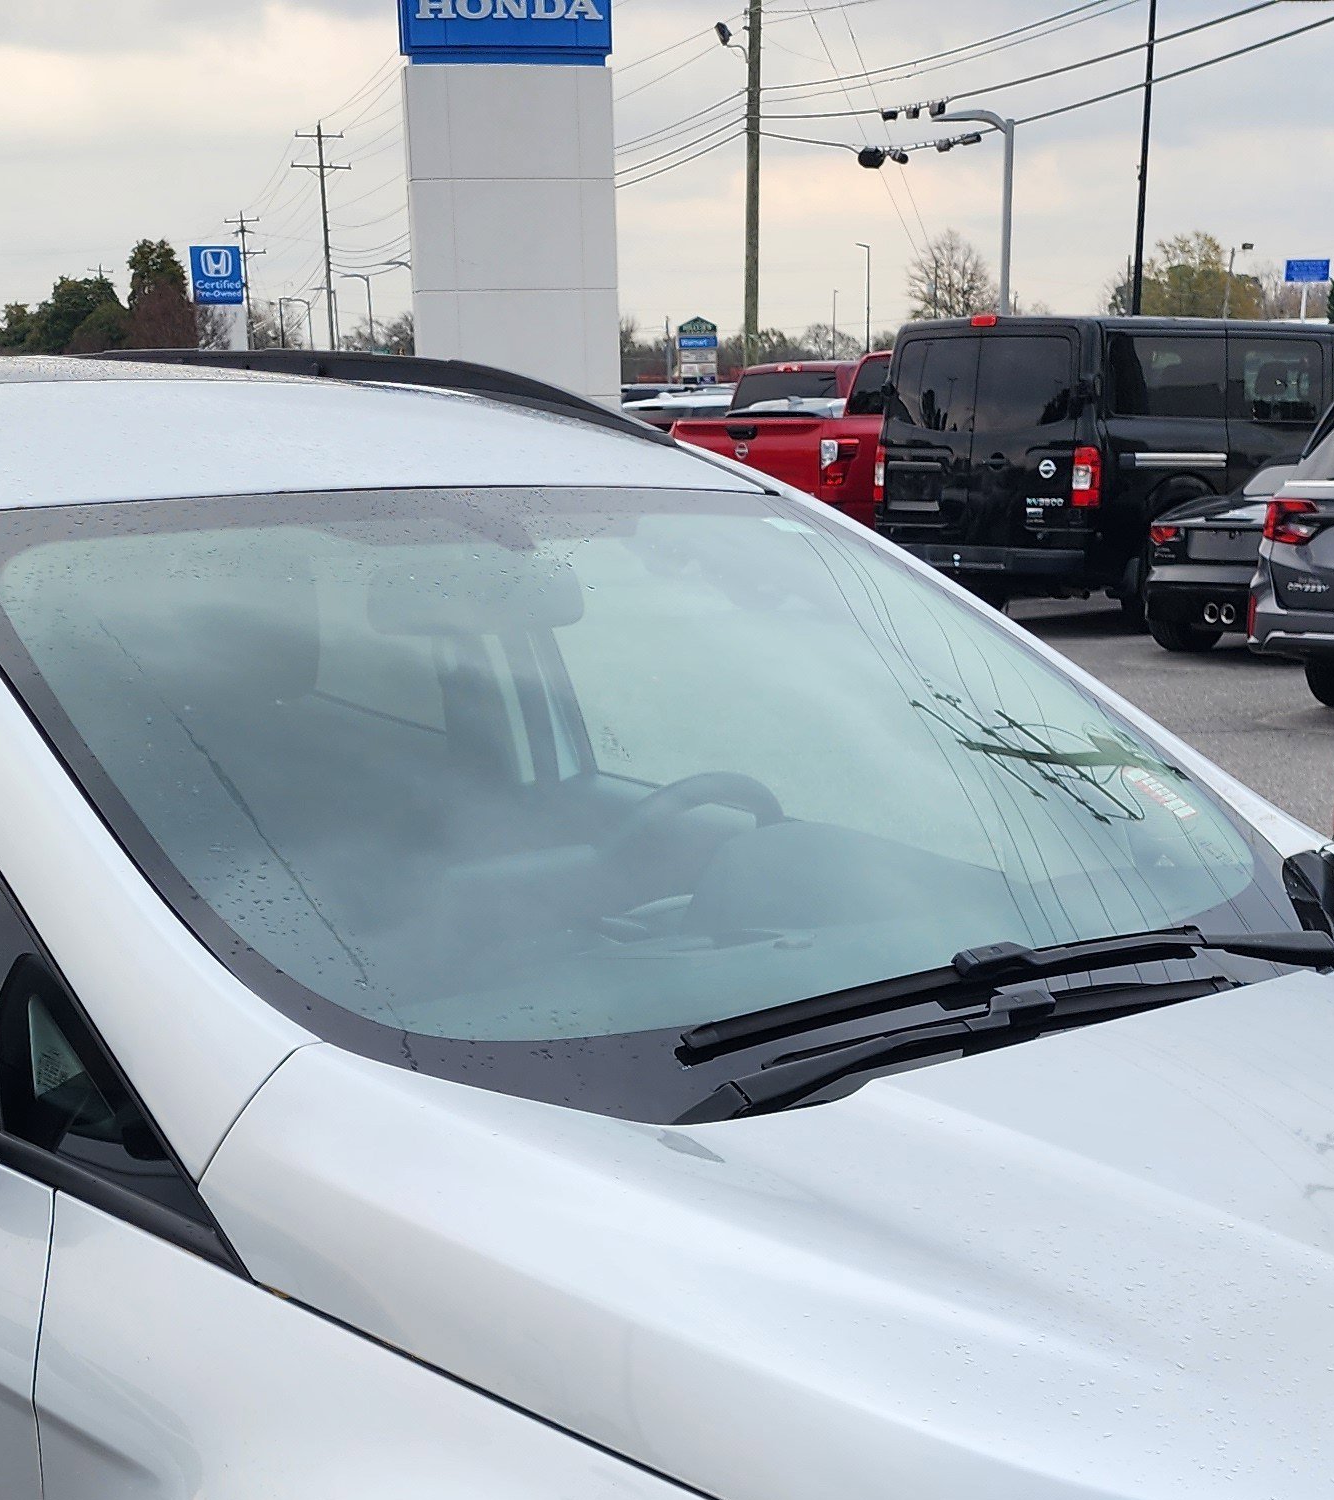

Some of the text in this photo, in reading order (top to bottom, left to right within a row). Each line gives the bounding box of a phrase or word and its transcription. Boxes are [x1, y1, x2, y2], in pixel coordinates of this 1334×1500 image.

[415, 0, 604, 20] HONDA
[196, 280, 242, 289] Certified
[196, 290, 242, 298] Pre-Owned
